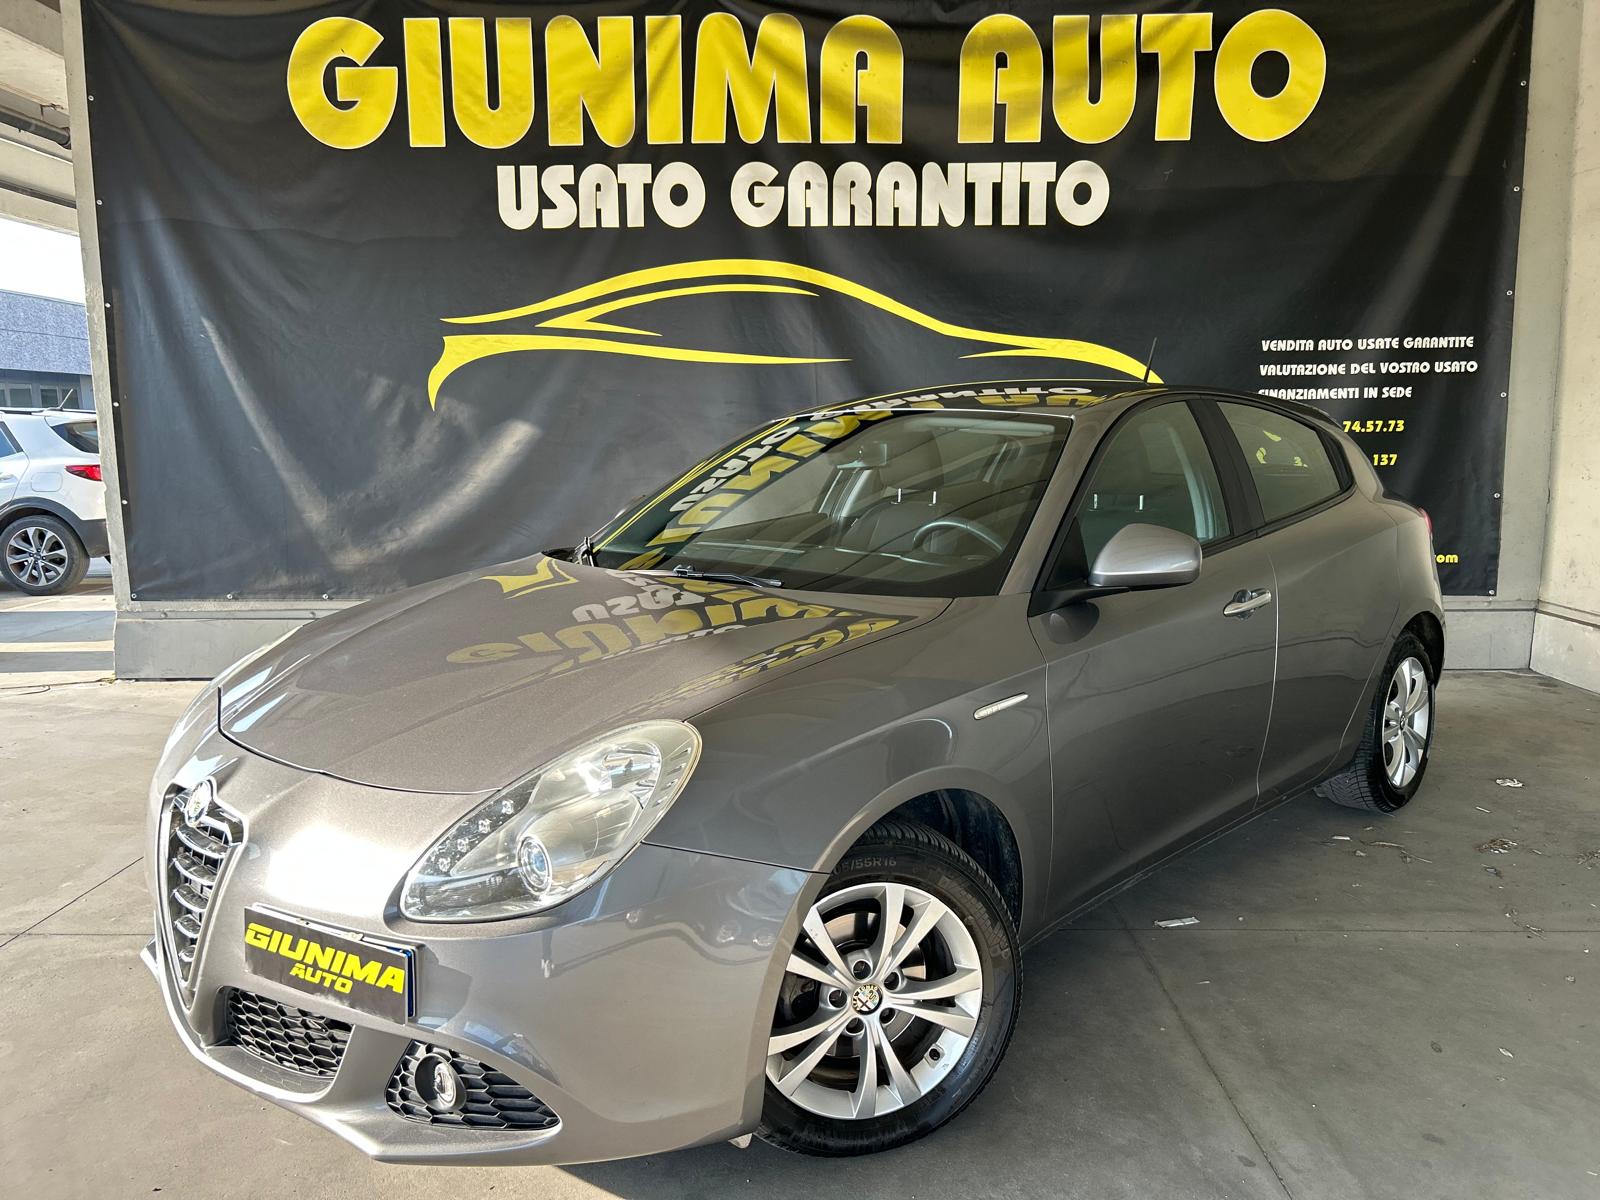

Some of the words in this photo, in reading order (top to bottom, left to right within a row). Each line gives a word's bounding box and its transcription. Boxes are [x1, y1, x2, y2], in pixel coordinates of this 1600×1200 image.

[287, 12, 904, 149] GIUNIMA
[958, 9, 1326, 144] AUTO
[497, 161, 706, 231] USATO
[730, 160, 1110, 228] GARANTITO
[1261, 339, 1314, 352] VENDITA
[1317, 338, 1354, 351] AUTO
[1357, 337, 1400, 350] USATE
[1403, 335, 1474, 349] GARANTITE
[1259, 363, 1346, 376] VALUTAZIONE
[1350, 362, 1376, 375] DEL
[1379, 361, 1431, 374] VOSTRO
[1434, 360, 1479, 373] USATO
[1363, 386, 1379, 399] IN
[1381, 386, 1413, 399] SEDE
[1434, 554, 1459, 564] om
[245, 922, 406, 994] GIUNIMA
[289, 962, 353, 994] AUTO
